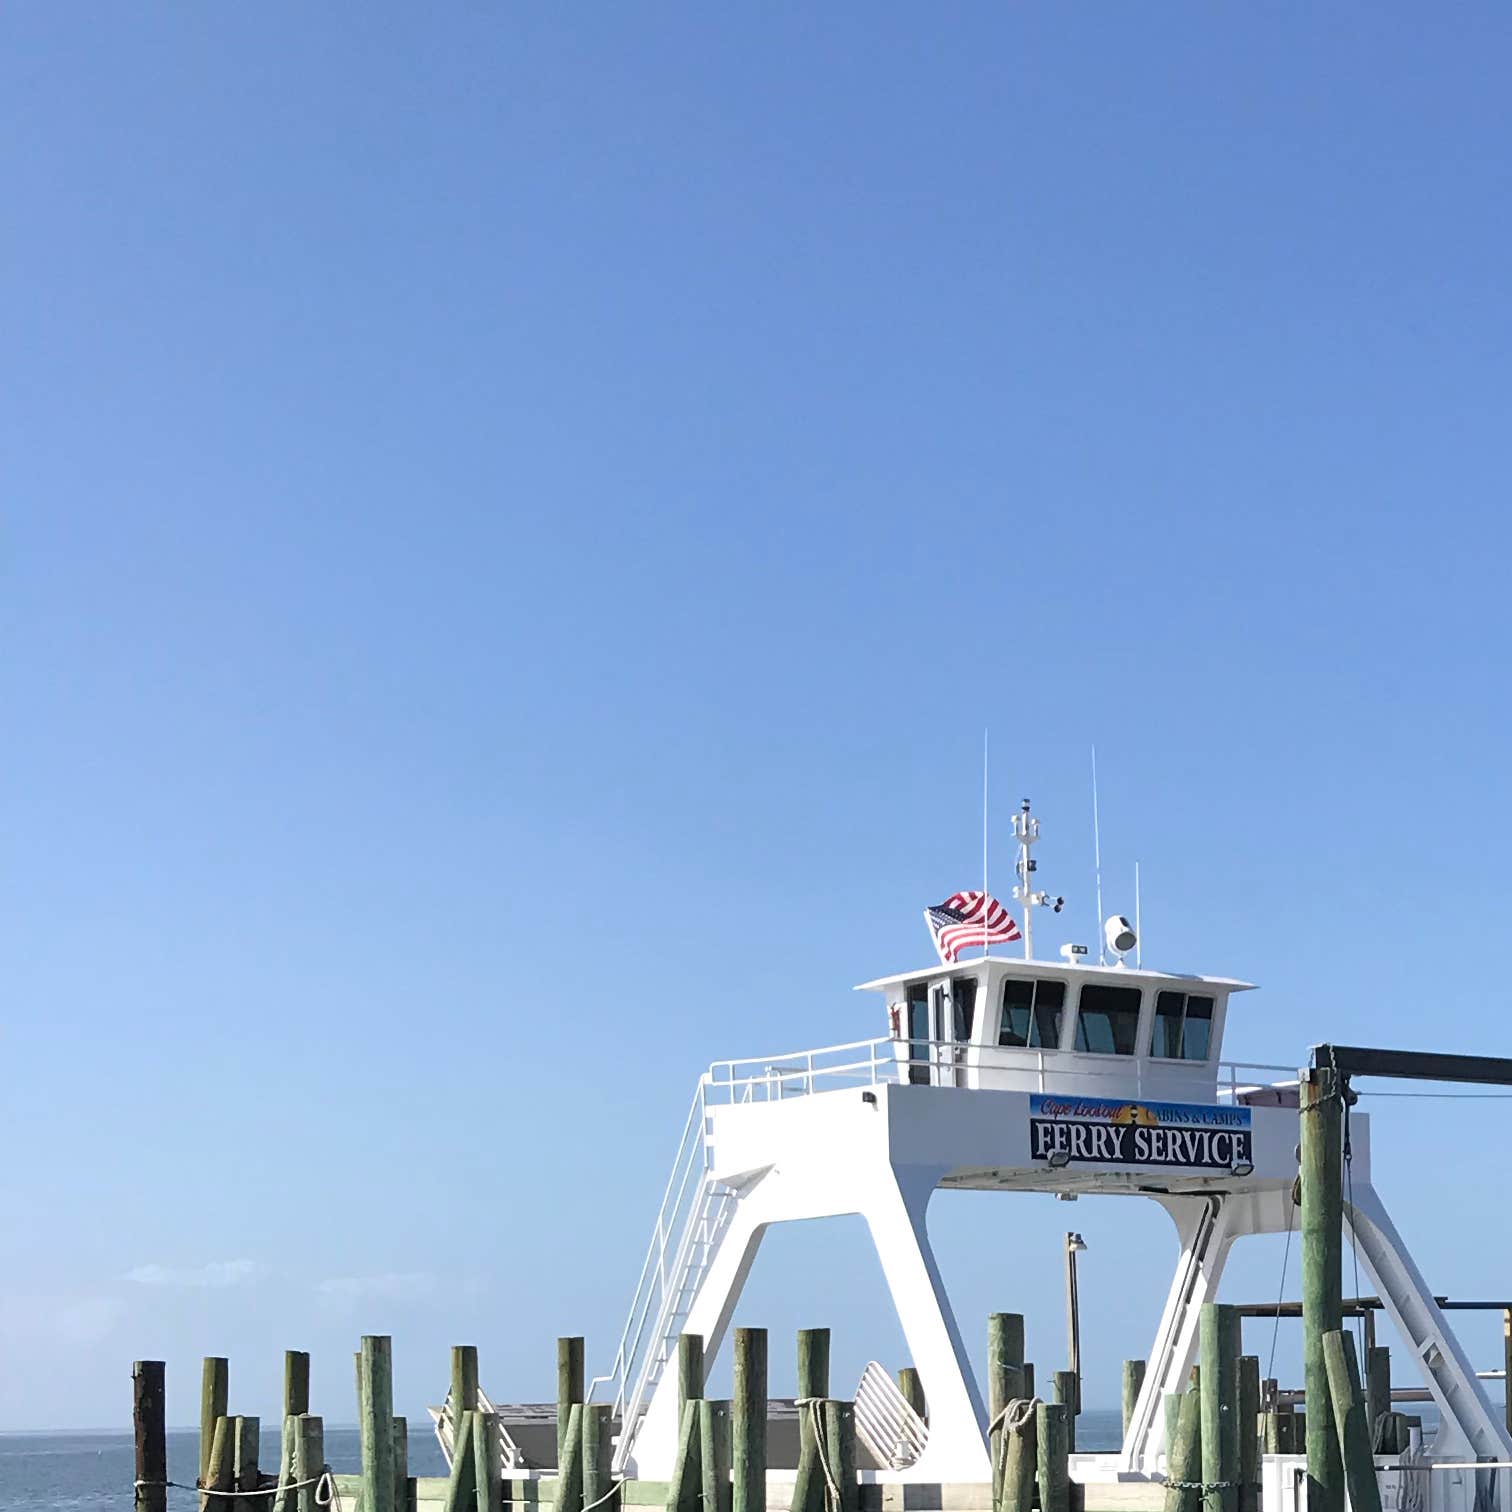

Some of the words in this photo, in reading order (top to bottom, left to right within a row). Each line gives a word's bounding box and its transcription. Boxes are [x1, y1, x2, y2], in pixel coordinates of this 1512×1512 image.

[1040, 1098, 1072, 1119] Cape
[1073, 1102, 1122, 1119] Lookout
[1146, 1108, 1190, 1124] CABINS
[1191, 1114, 1201, 1124] &
[1202, 1111, 1242, 1126] CAMPS
[1035, 1122, 1127, 1159] FERRY
[1134, 1127, 1246, 1164] SERVICE
